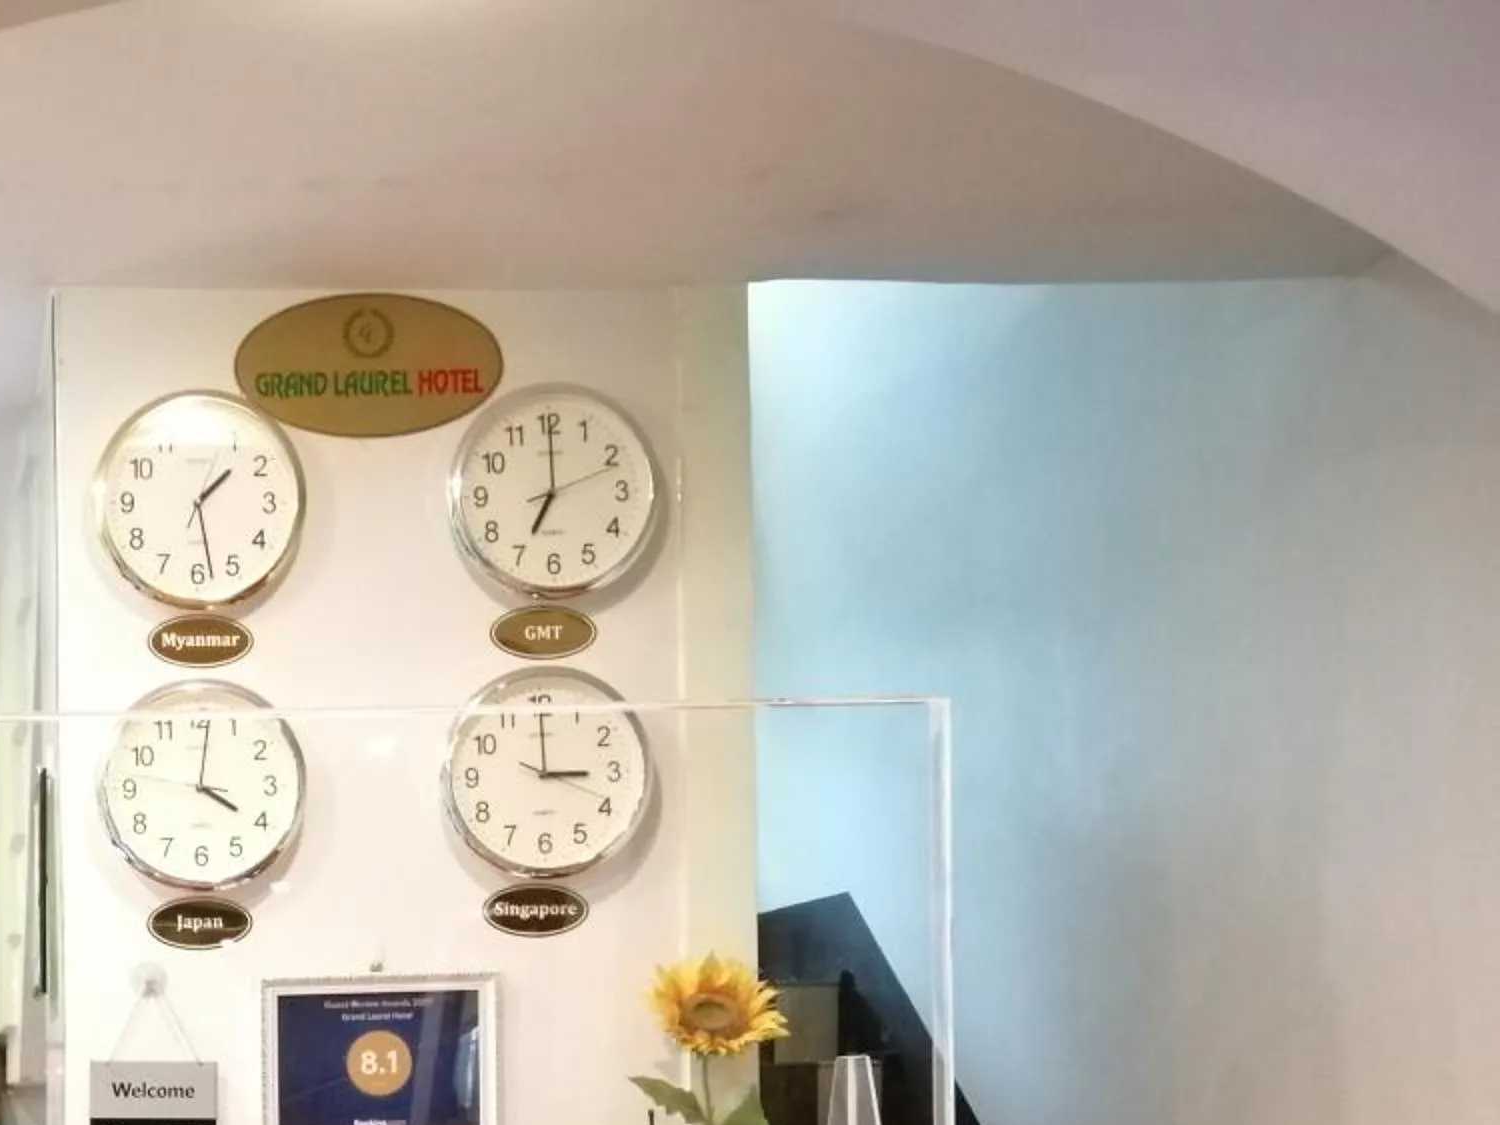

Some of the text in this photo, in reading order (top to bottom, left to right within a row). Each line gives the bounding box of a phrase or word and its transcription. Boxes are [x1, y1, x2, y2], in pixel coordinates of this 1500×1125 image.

[254, 367, 485, 398] GRAND LAUREL HOTEL
[537, 412, 561, 435] 12
[578, 420, 588, 442] 1
[505, 426, 524, 446] 11
[253, 455, 268, 477] 2
[481, 451, 505, 475] 10
[604, 444, 619, 467] 2
[130, 458, 153, 480] 10
[120, 491, 135, 513] 9
[474, 486, 488, 508] 9
[615, 480, 629, 502] 3
[263, 491, 277, 514] 3
[485, 520, 499, 543] 8
[606, 517, 620, 538] 4
[129, 528, 144, 550] 8
[252, 529, 267, 550] 4
[157, 554, 170, 575] 7
[512, 545, 527, 566] 7
[547, 553, 561, 575] 6
[581, 544, 596, 565] 5
[191, 564, 206, 585] 6
[226, 555, 240, 577] 5
[161, 632, 240, 650] Myanmar
[524, 625, 563, 641] GMT
[153, 719, 173, 740] 11
[597, 726, 611, 747] 2
[253, 739, 268, 761] 2
[474, 733, 497, 755] 10
[131, 745, 154, 767] 10
[465, 767, 479, 789] 9
[607, 761, 621, 783] 3
[122, 778, 137, 800] 9
[263, 776, 277, 797] 3
[476, 801, 490, 823] 8
[597, 797, 612, 817] 4
[133, 813, 147, 835] 8
[253, 811, 268, 831] 4
[504, 825, 517, 846] 7
[538, 833, 552, 854] 6
[573, 823, 588, 845] 5
[160, 838, 174, 858] 7
[194, 846, 209, 867] 6
[229, 836, 243, 857] 5
[494, 900, 578, 920] Singapore
[176, 914, 224, 933] Japan
[360, 1050, 398, 1075] 8.1
[111, 1081, 195, 1098] Welcome
